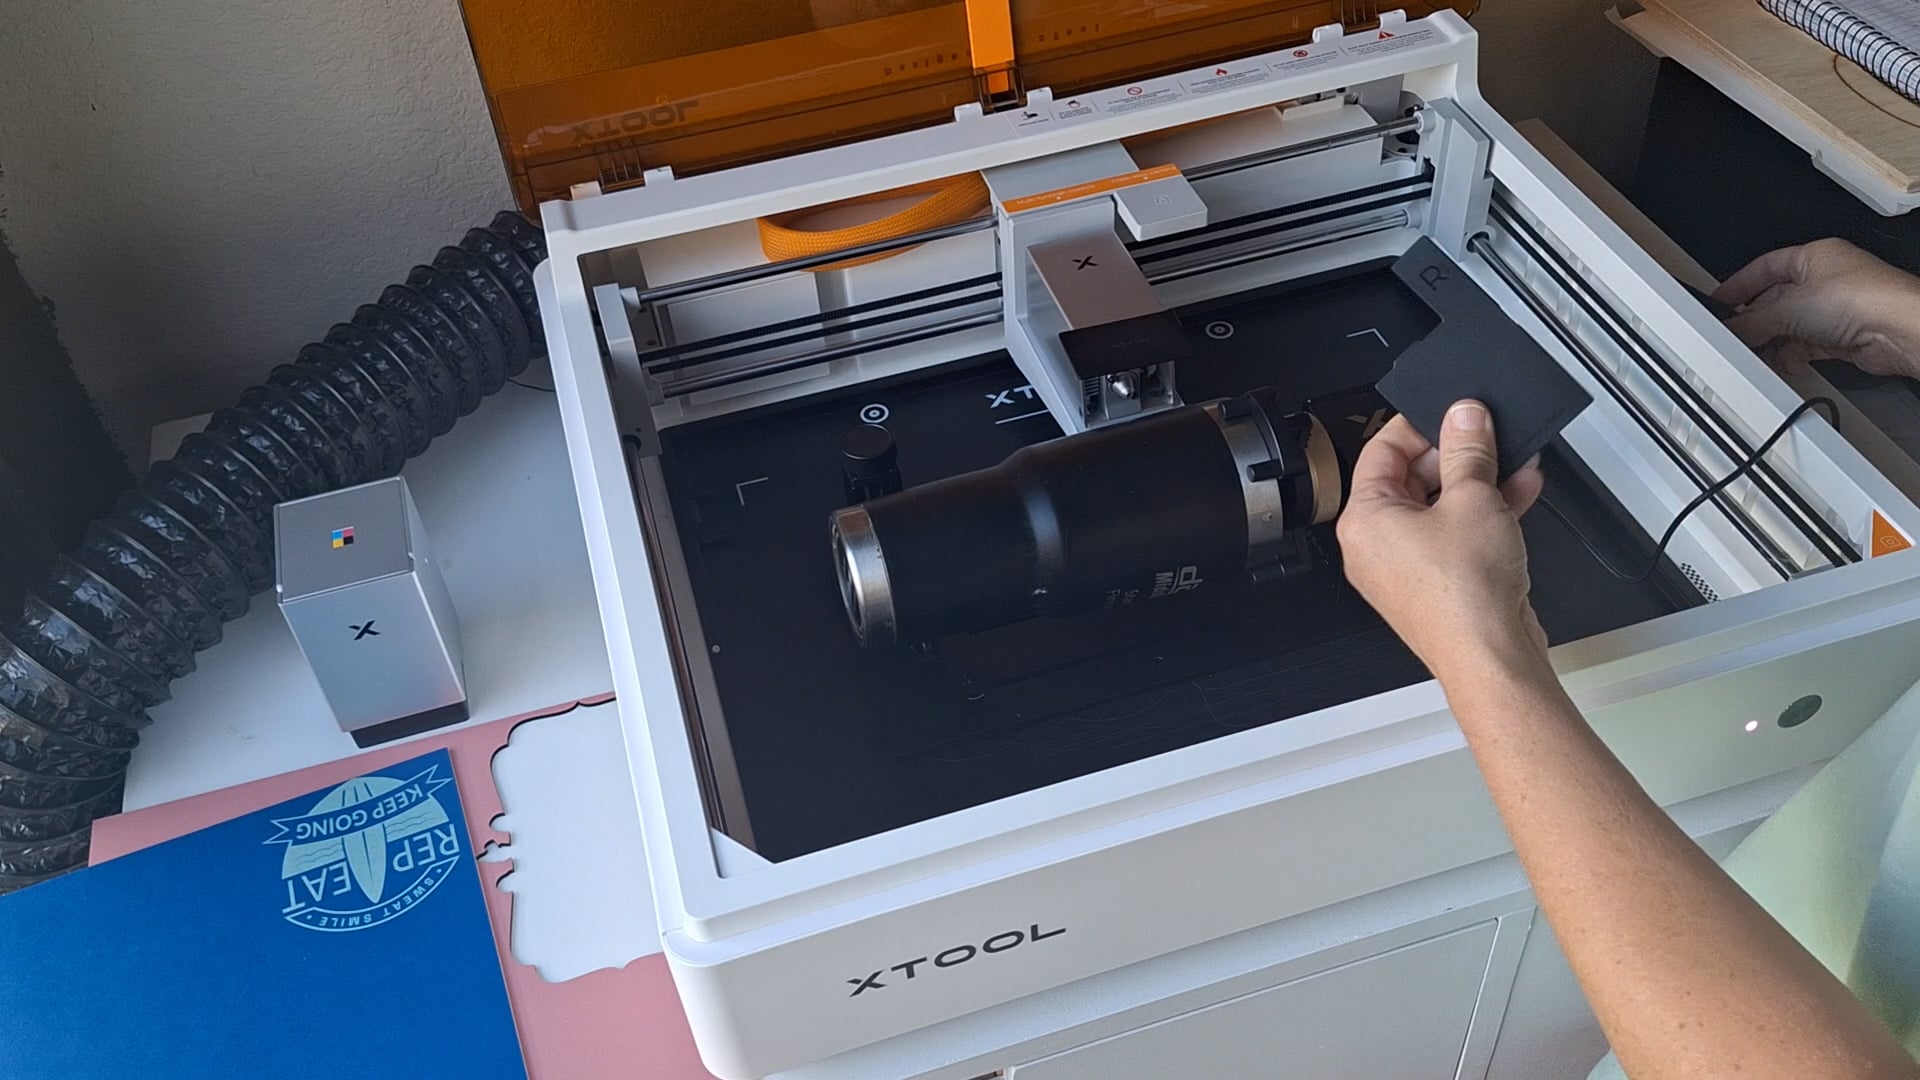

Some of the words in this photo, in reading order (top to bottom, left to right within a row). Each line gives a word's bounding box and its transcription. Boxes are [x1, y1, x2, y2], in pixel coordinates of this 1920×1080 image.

[1419, 265, 1449, 291] R
[372, 783, 424, 819] KEEP
[296, 809, 368, 840] GOING
[392, 823, 460, 872] REP
[282, 860, 352, 914] EAT
[382, 877, 435, 918] SWEAT
[319, 913, 372, 927] SMILE
